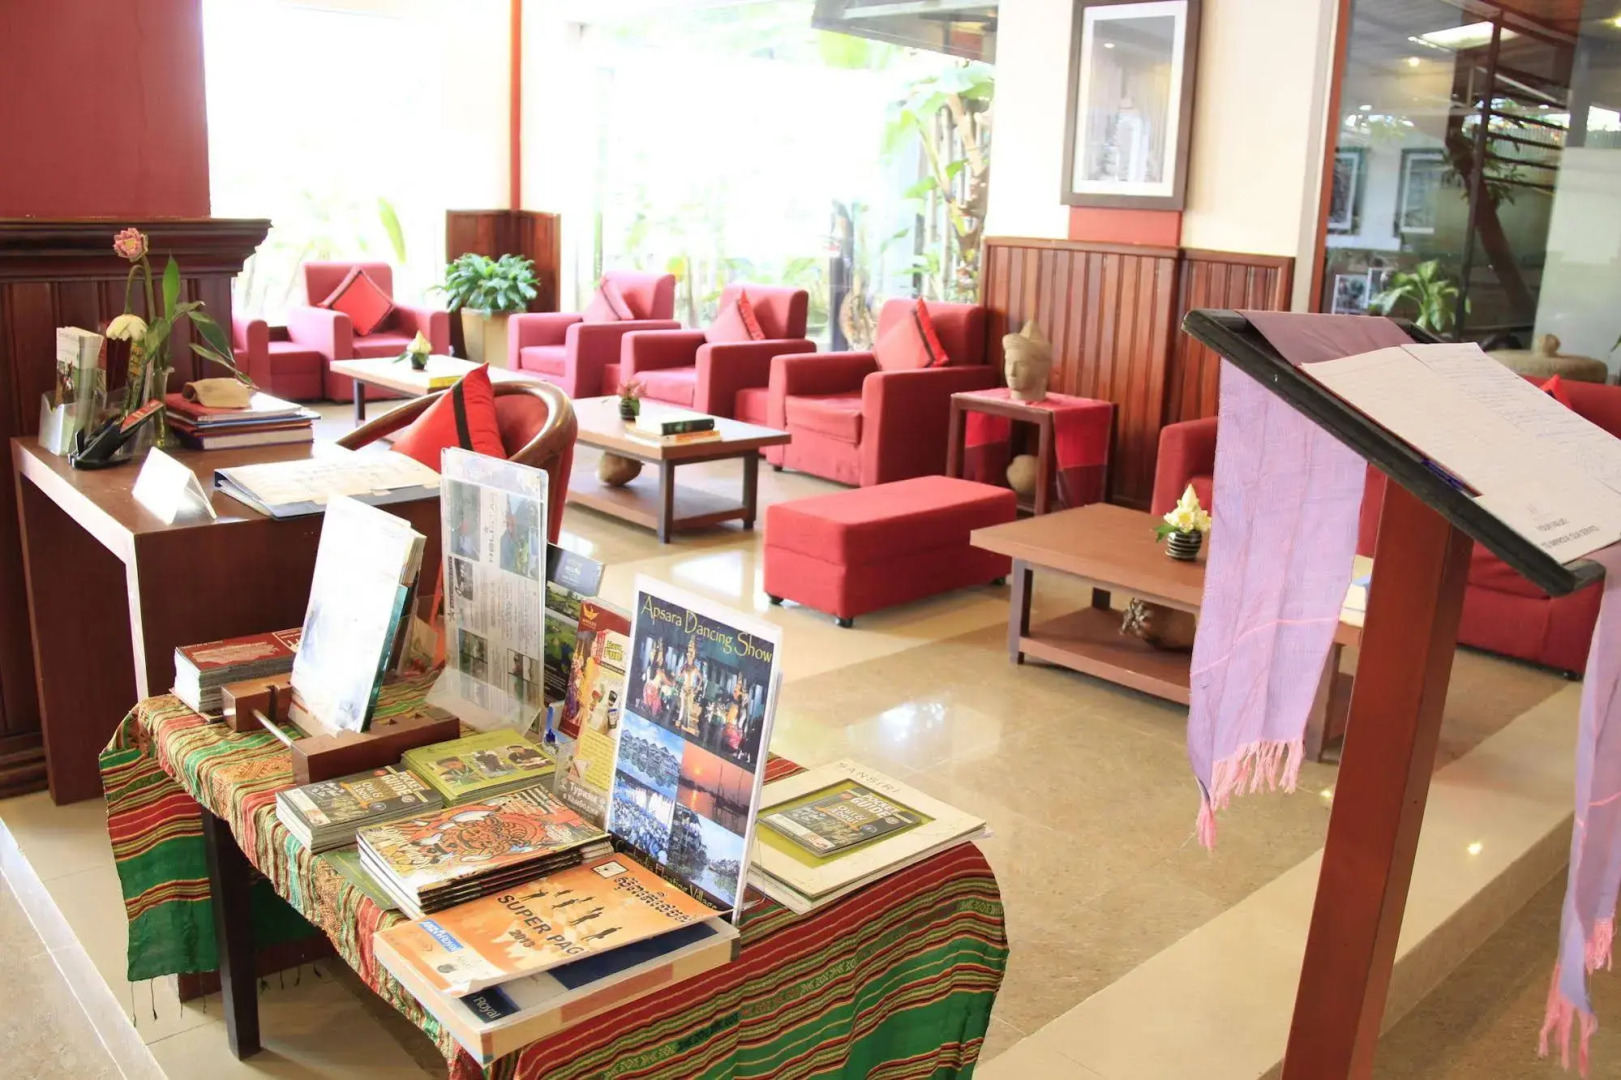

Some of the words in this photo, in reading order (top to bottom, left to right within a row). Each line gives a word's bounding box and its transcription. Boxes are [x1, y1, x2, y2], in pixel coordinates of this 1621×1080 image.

[641, 596, 682, 625] Apsara
[684, 610, 733, 654] Dancing
[734, 632, 773, 664] Show
[381, 774, 413, 797] GUIDE
[850, 797, 891, 818] GUIDE
[862, 793, 900, 814] POCKET
[497, 895, 552, 934] SUPER
[508, 929, 536, 948] 2013
[473, 996, 502, 1019] Royal
